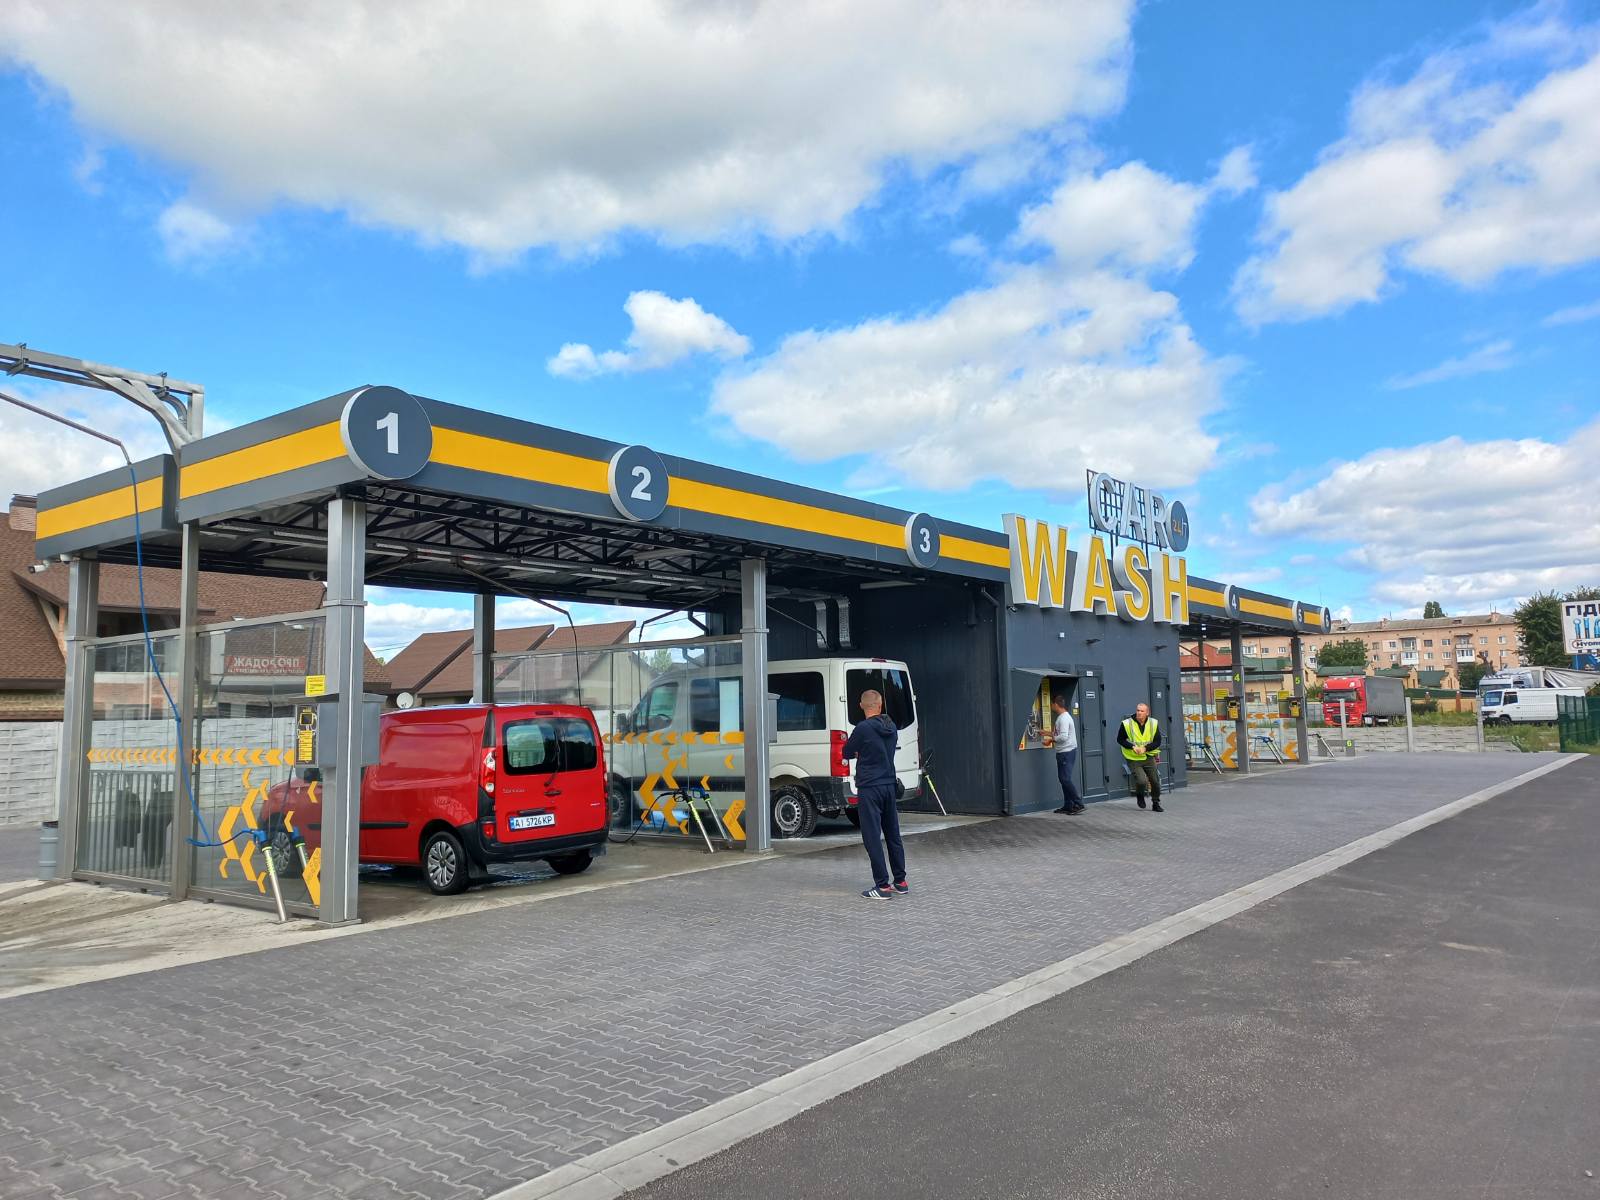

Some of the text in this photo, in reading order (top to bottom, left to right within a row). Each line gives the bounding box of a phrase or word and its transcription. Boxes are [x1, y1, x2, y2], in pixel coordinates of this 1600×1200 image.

[376, 412, 399, 454] 1
[631, 465, 651, 501] 2
[1090, 472, 1168, 548] CAR
[1172, 518, 1188, 539] 24/7
[920, 527, 930, 553] 3
[1002, 513, 1190, 626] WASH
[1231, 594, 1237, 610] 4
[1565, 603, 1600, 617] ГІД
[1234, 673, 1241, 682] 4
[1295, 676, 1301, 684] 5
[526, 817, 542, 826] 5726
[543, 815, 553, 824] KP
